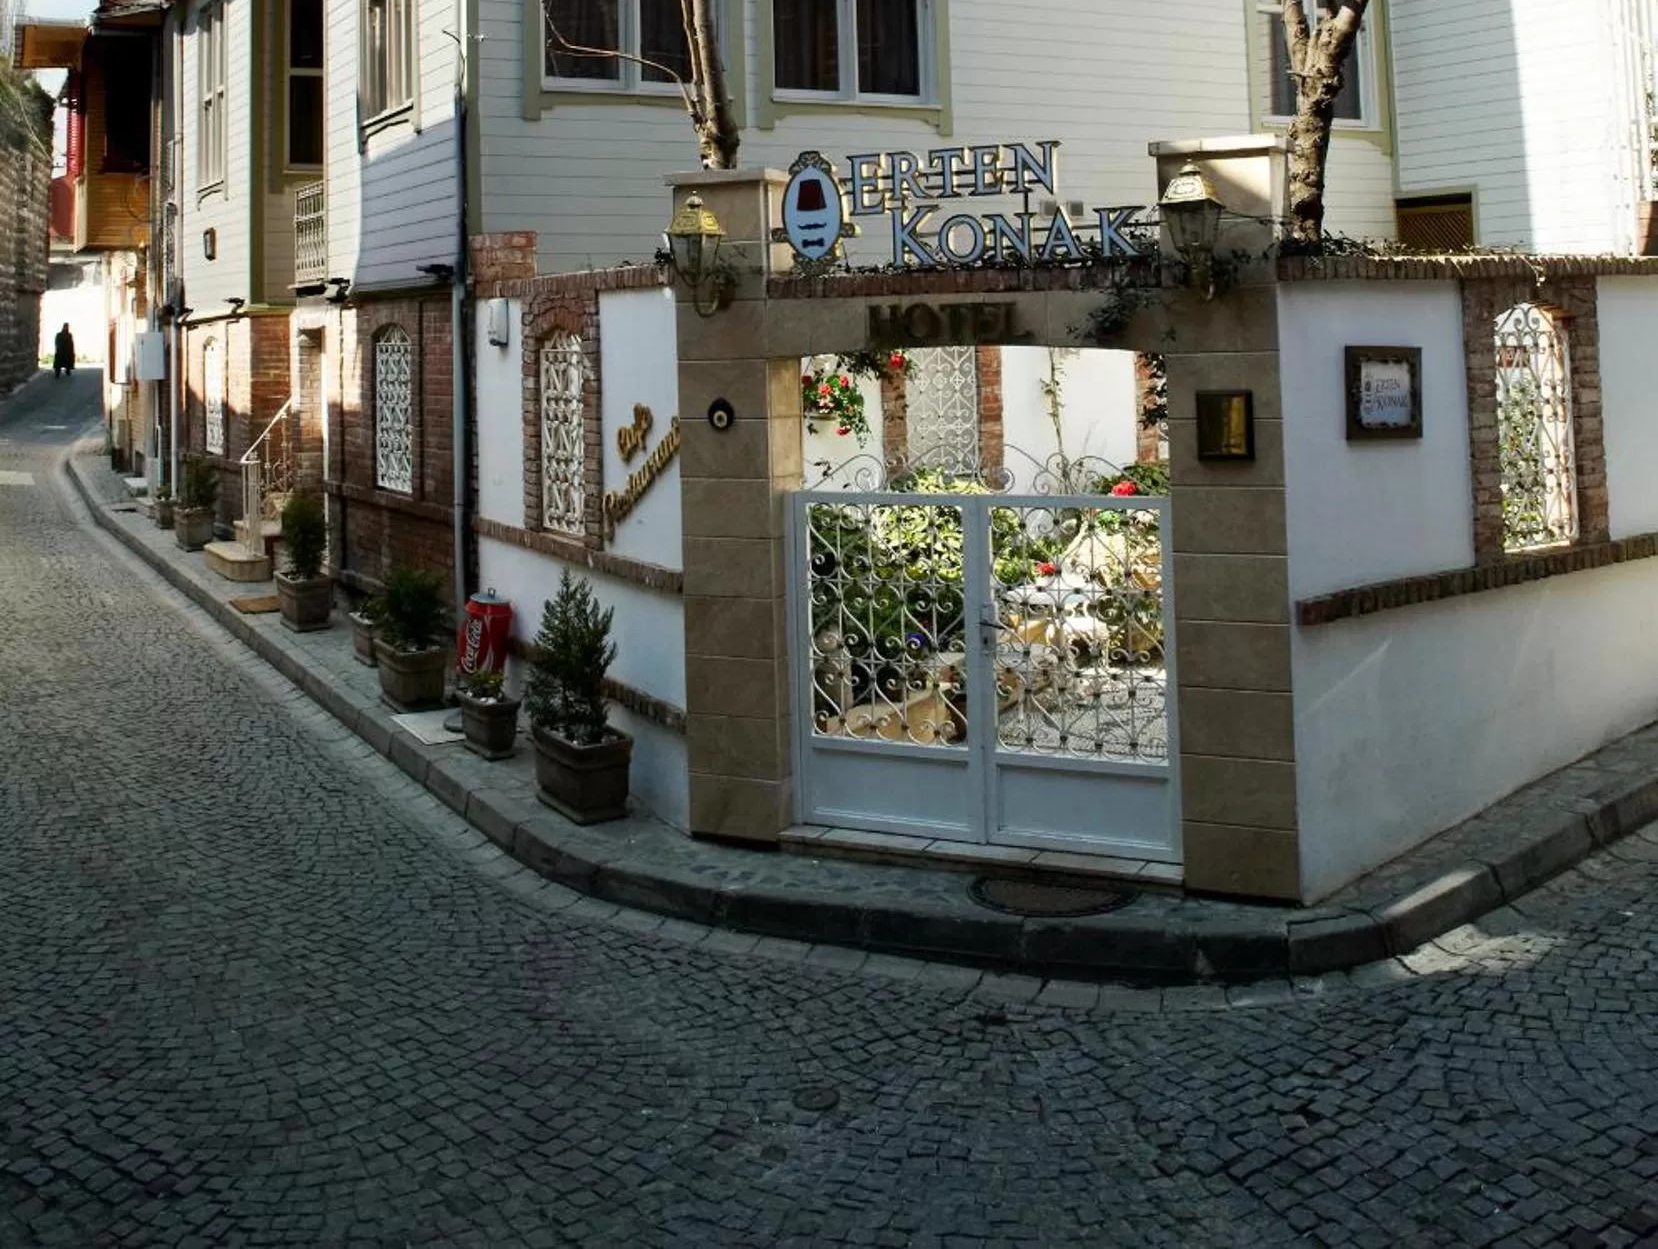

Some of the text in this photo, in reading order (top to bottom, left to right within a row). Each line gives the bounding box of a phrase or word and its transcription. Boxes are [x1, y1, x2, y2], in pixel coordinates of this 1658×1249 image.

[846, 140, 1062, 216] ERTEN
[889, 204, 1147, 269] KONAK
[866, 301, 1033, 343] HOTEL
